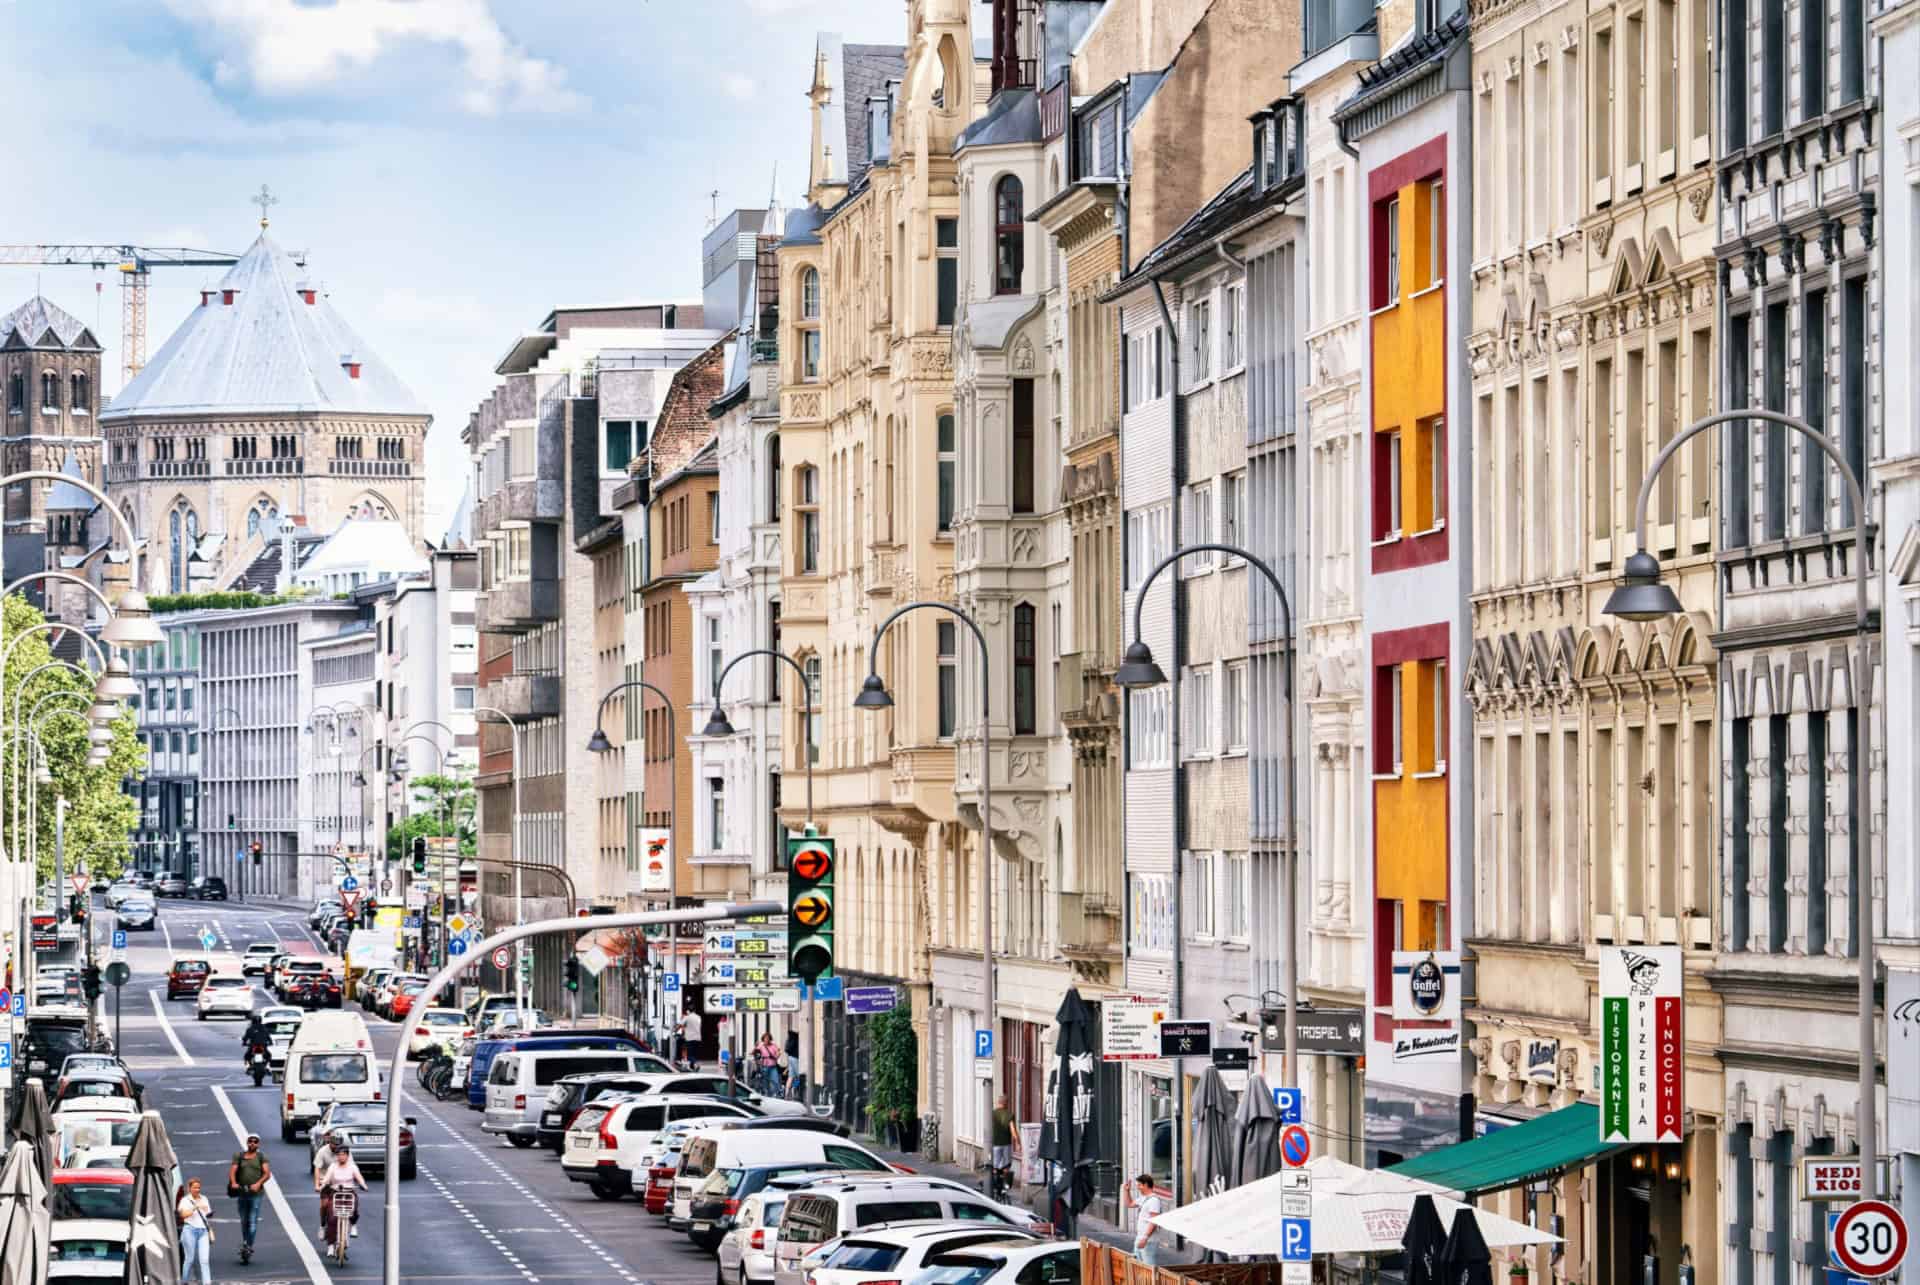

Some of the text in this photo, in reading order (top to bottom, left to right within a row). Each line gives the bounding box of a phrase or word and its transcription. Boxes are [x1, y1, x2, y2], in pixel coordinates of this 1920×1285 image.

[1412, 979, 1441, 991] Gaffel
[979, 1034, 989, 1054] P
[1296, 1025, 1342, 1040] TROSPIEL
[1611, 1001, 1622, 1126] RISTORANTE
[1638, 1001, 1648, 1125] PIZZERIA
[1663, 1001, 1674, 1126] PINOCCHIO
[1814, 1167, 1861, 1179] MEDI
[1815, 1180, 1862, 1191] KIOS
[1285, 1223, 1303, 1256] P
[1850, 1222, 1892, 1255] 30
